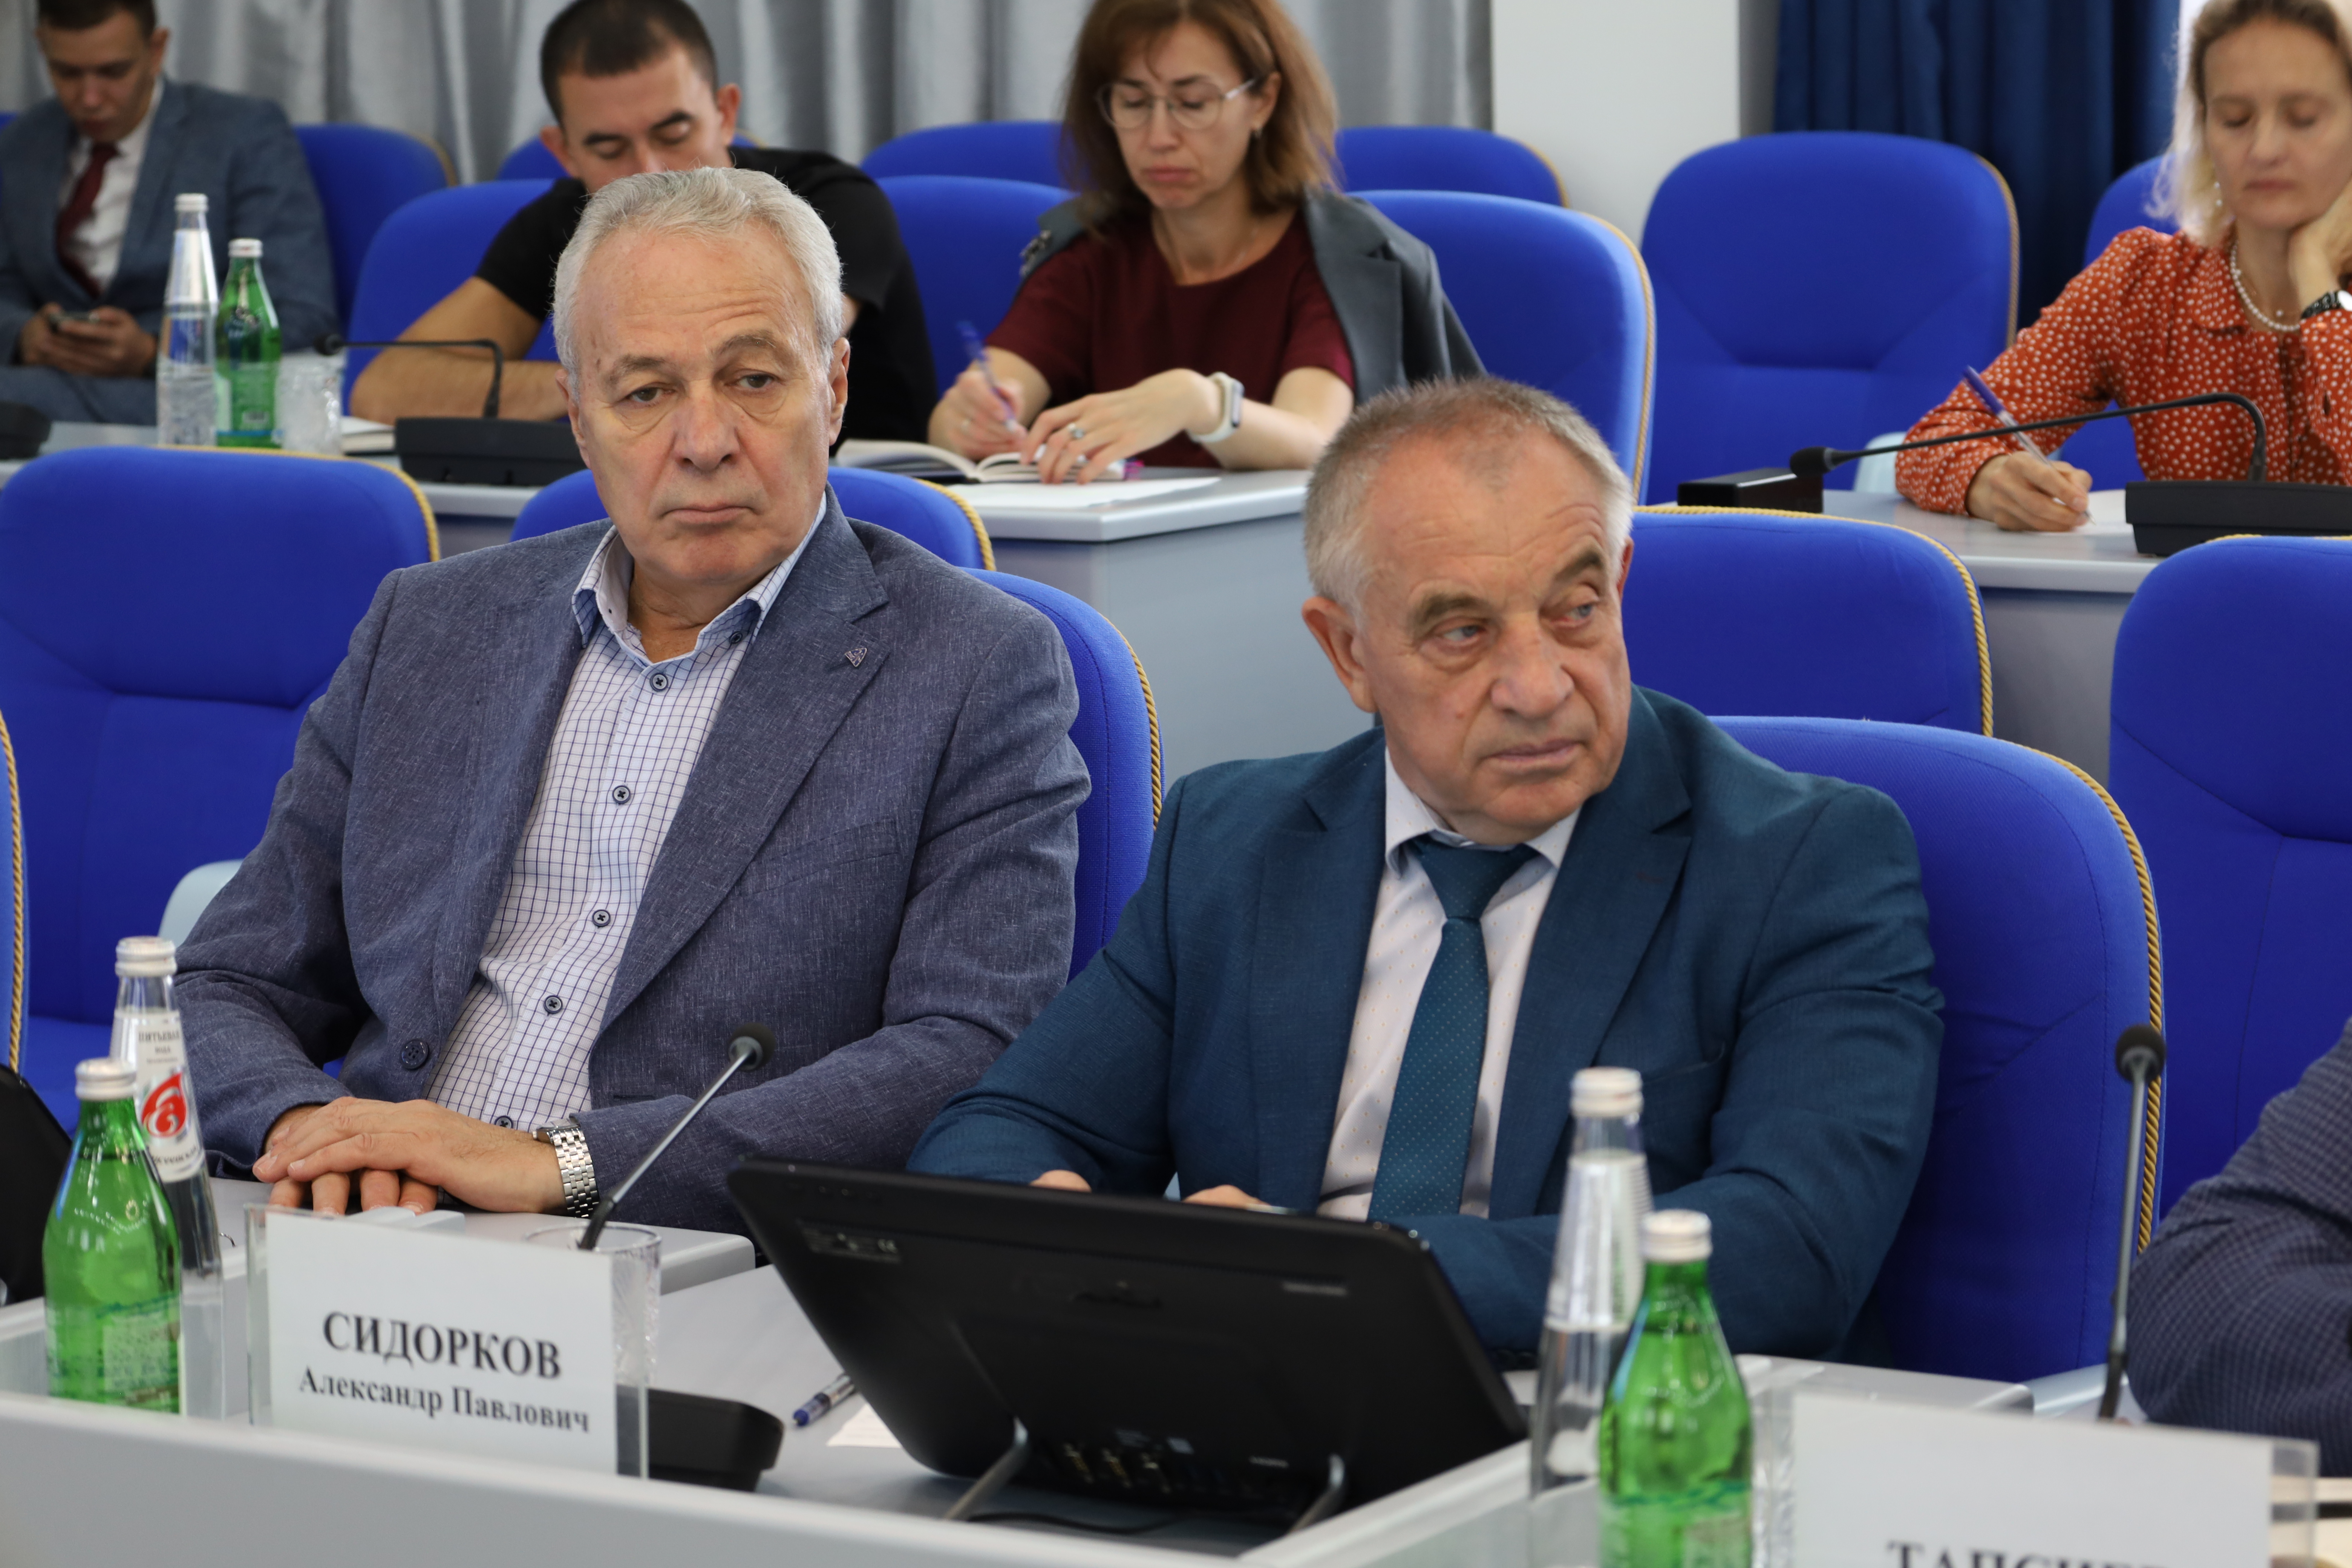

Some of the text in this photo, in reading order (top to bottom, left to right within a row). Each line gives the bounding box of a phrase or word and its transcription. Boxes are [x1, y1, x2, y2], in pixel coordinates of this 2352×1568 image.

[323, 1312, 561, 1380] СИДОРКОВ
[300, 1365, 590, 1433] Александр Павлович
